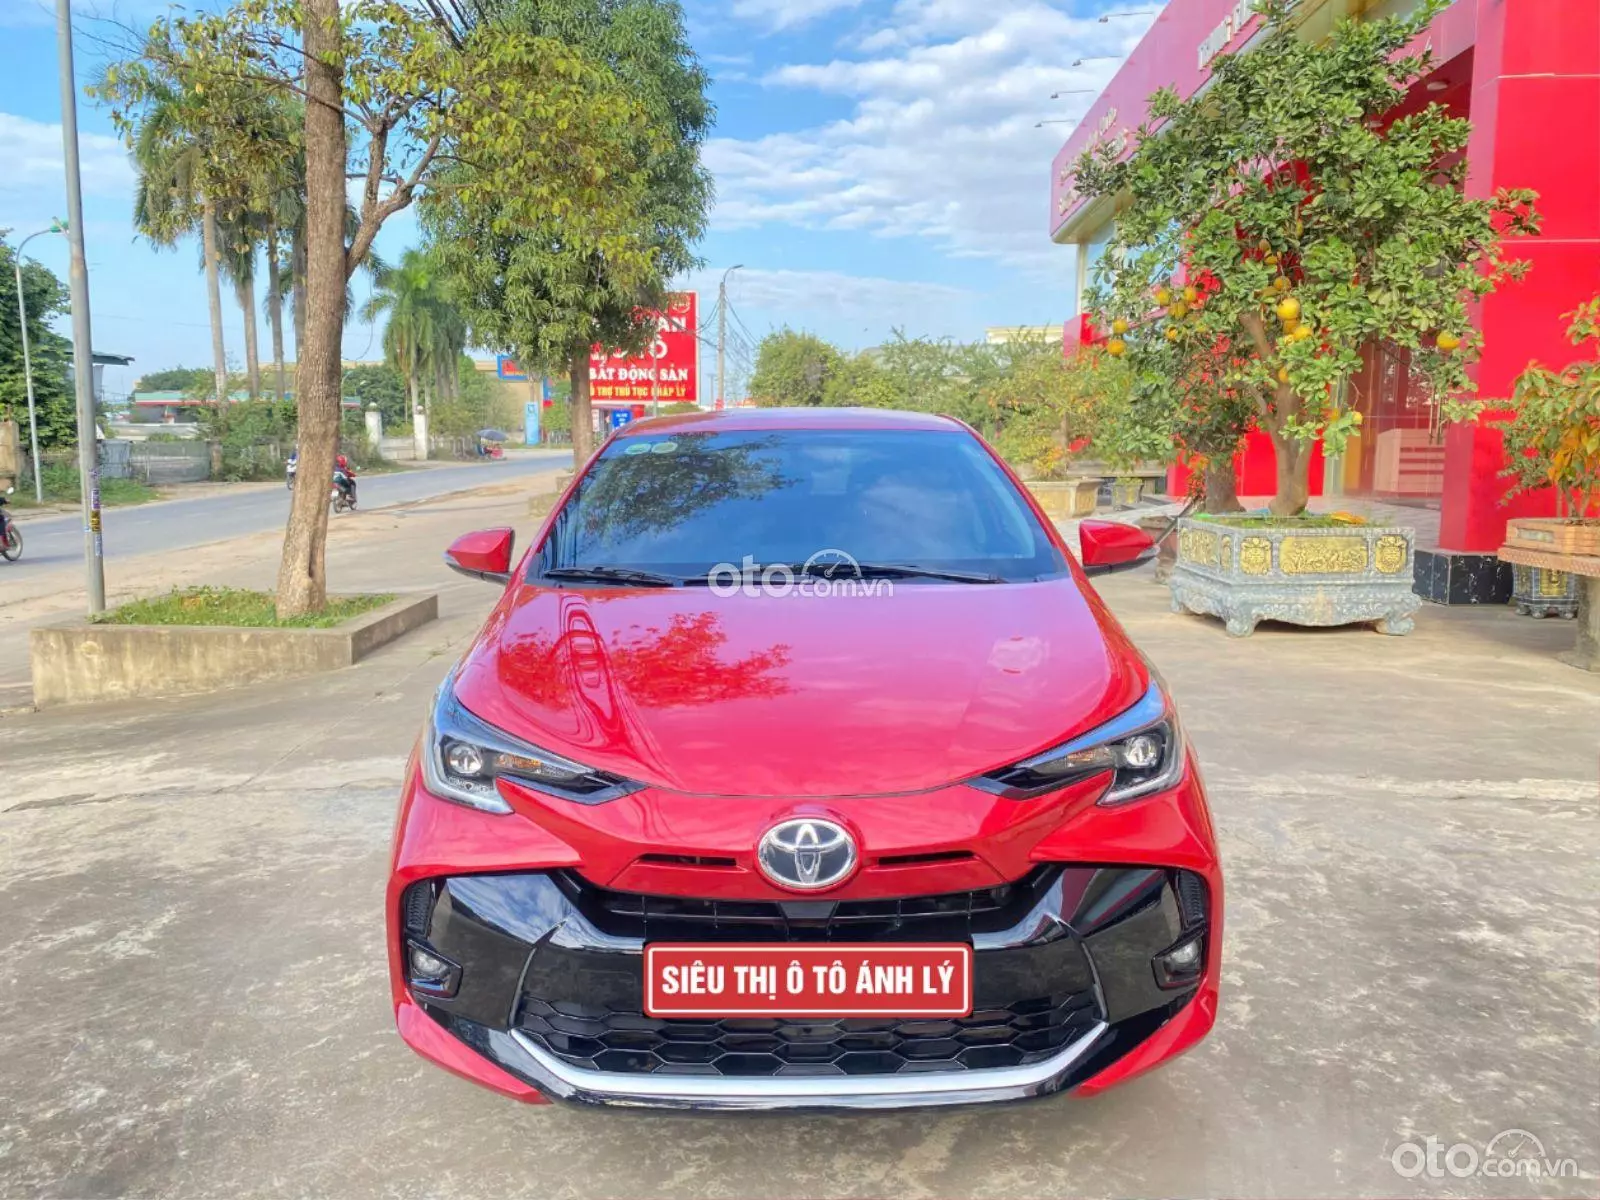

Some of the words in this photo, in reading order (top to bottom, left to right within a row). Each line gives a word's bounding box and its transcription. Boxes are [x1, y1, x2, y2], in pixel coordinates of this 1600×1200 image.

[660, 363, 688, 380] SẢN
[661, 960, 724, 995] SIÊU
[734, 965, 777, 1000] THỊ
[786, 960, 804, 995] Ô
[812, 960, 846, 995] TÔ
[855, 960, 913, 995] ÁNH
[922, 960, 955, 995] LÝ
